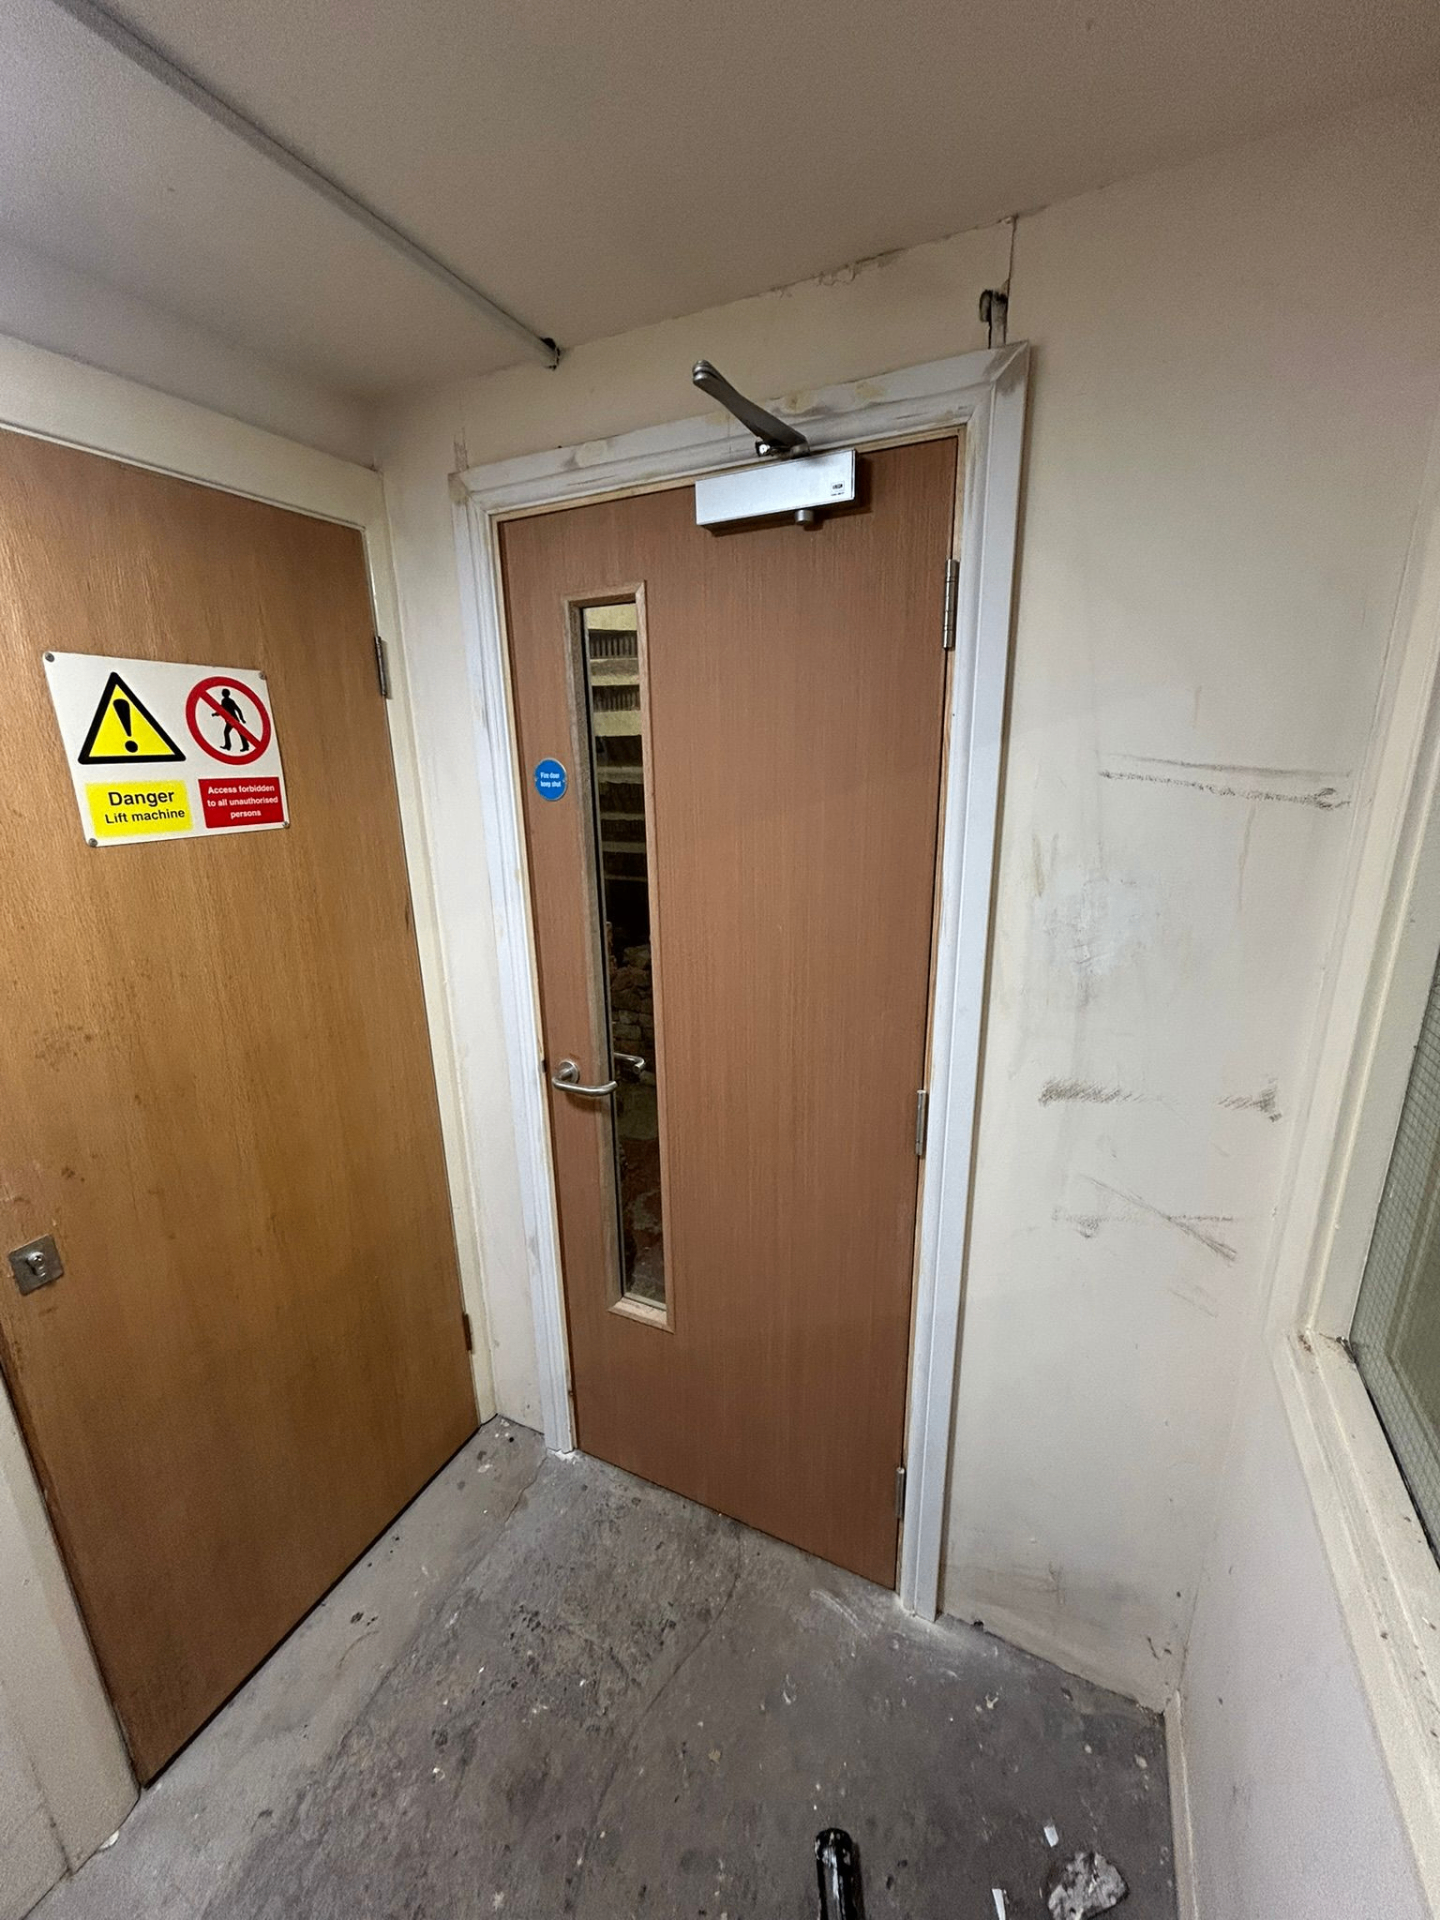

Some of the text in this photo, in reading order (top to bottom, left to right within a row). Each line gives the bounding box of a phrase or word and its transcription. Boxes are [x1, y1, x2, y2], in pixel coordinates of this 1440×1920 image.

[208, 785, 275, 794] Access forbidden
[108, 791, 175, 807] Danger
[207, 796, 279, 807] to all unauthorised
[105, 809, 185, 824] Lift machine
[230, 810, 262, 820] persons
